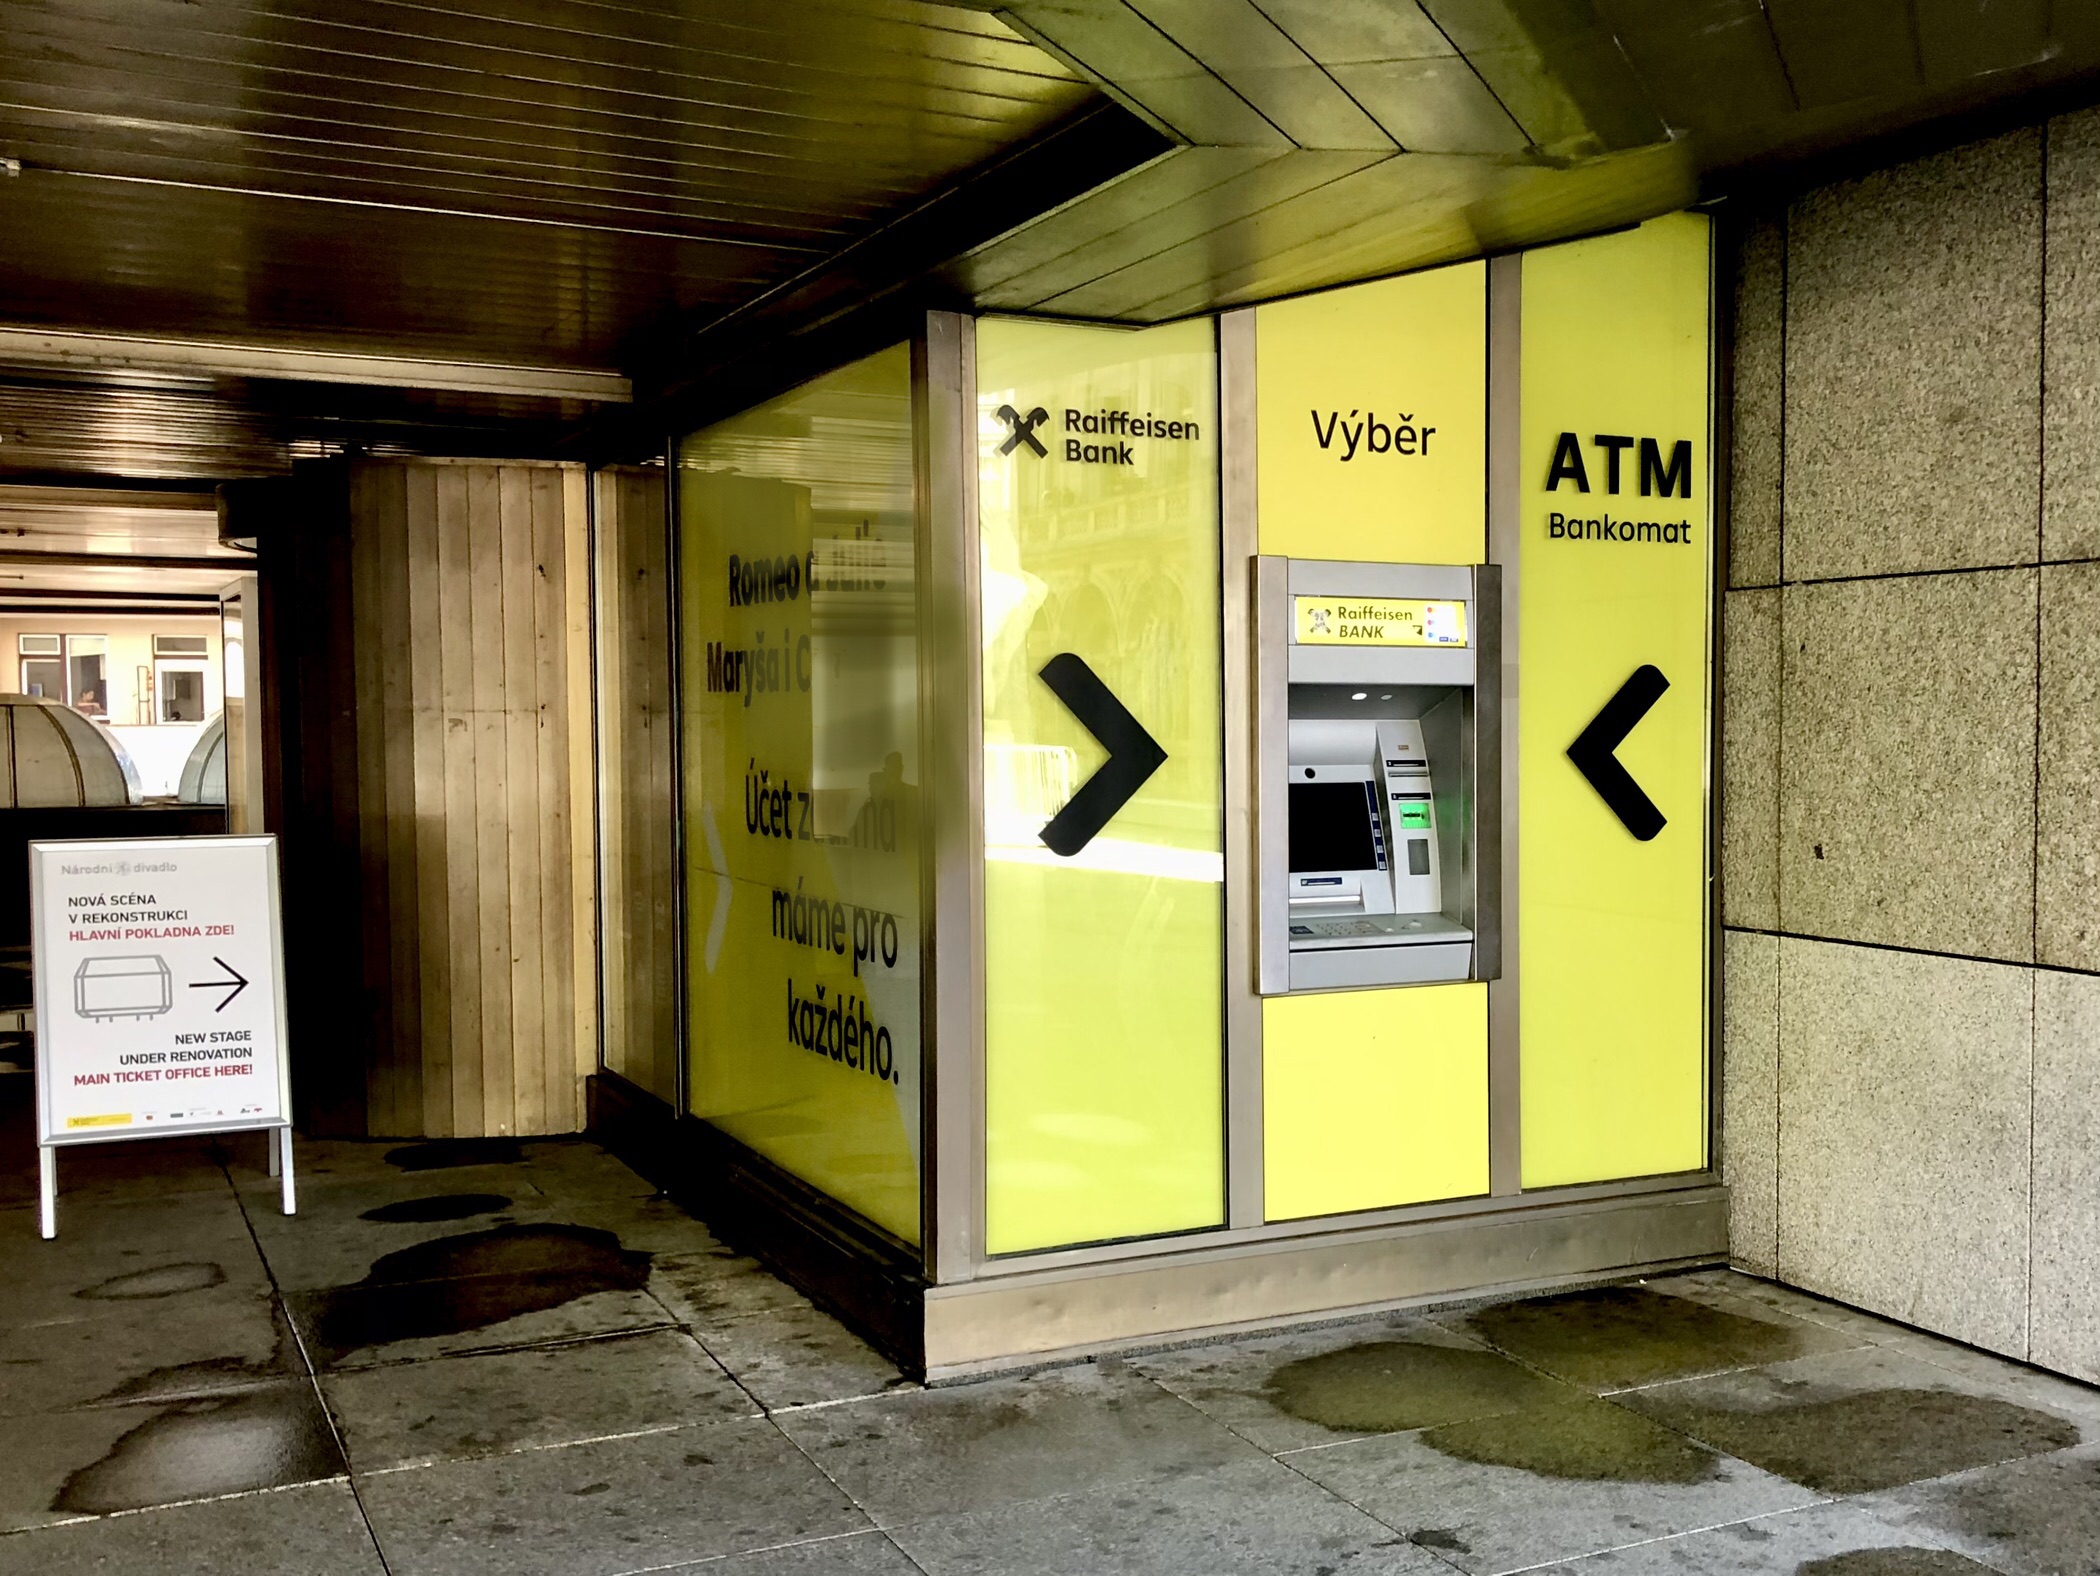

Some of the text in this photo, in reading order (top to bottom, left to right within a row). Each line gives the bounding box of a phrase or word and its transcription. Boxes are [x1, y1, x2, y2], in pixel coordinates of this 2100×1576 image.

[1064, 408, 1200, 441] Raiffeisen
[1310, 409, 1436, 462] Výběr
[1065, 438, 1134, 466] Bank
[1545, 431, 1693, 499] ATM
[1549, 512, 1692, 544] Bankomat
[728, 553, 801, 608] Romeo
[1337, 605, 1413, 622] Raiffeisen
[1339, 624, 1385, 639] BANK
[706, 630, 780, 709] Maryša
[783, 626, 792, 692] i
[745, 757, 793, 839] Účet
[133, 861, 178, 874] divadlo
[68, 891, 157, 908] NOVÁ SCÉNA
[68, 910, 188, 925] V REKONSTRUKCI
[772, 876, 899, 978] máme pro
[69, 924, 235, 942] HLAVNÍ POKLADNA ZDE!
[175, 1030, 252, 1046] NEW STAGE
[787, 977, 900, 1086] každého.
[120, 1047, 253, 1066] UNDER RENOVATION
[74, 1064, 254, 1087] MAIN TICKET OFFICE HERE!
